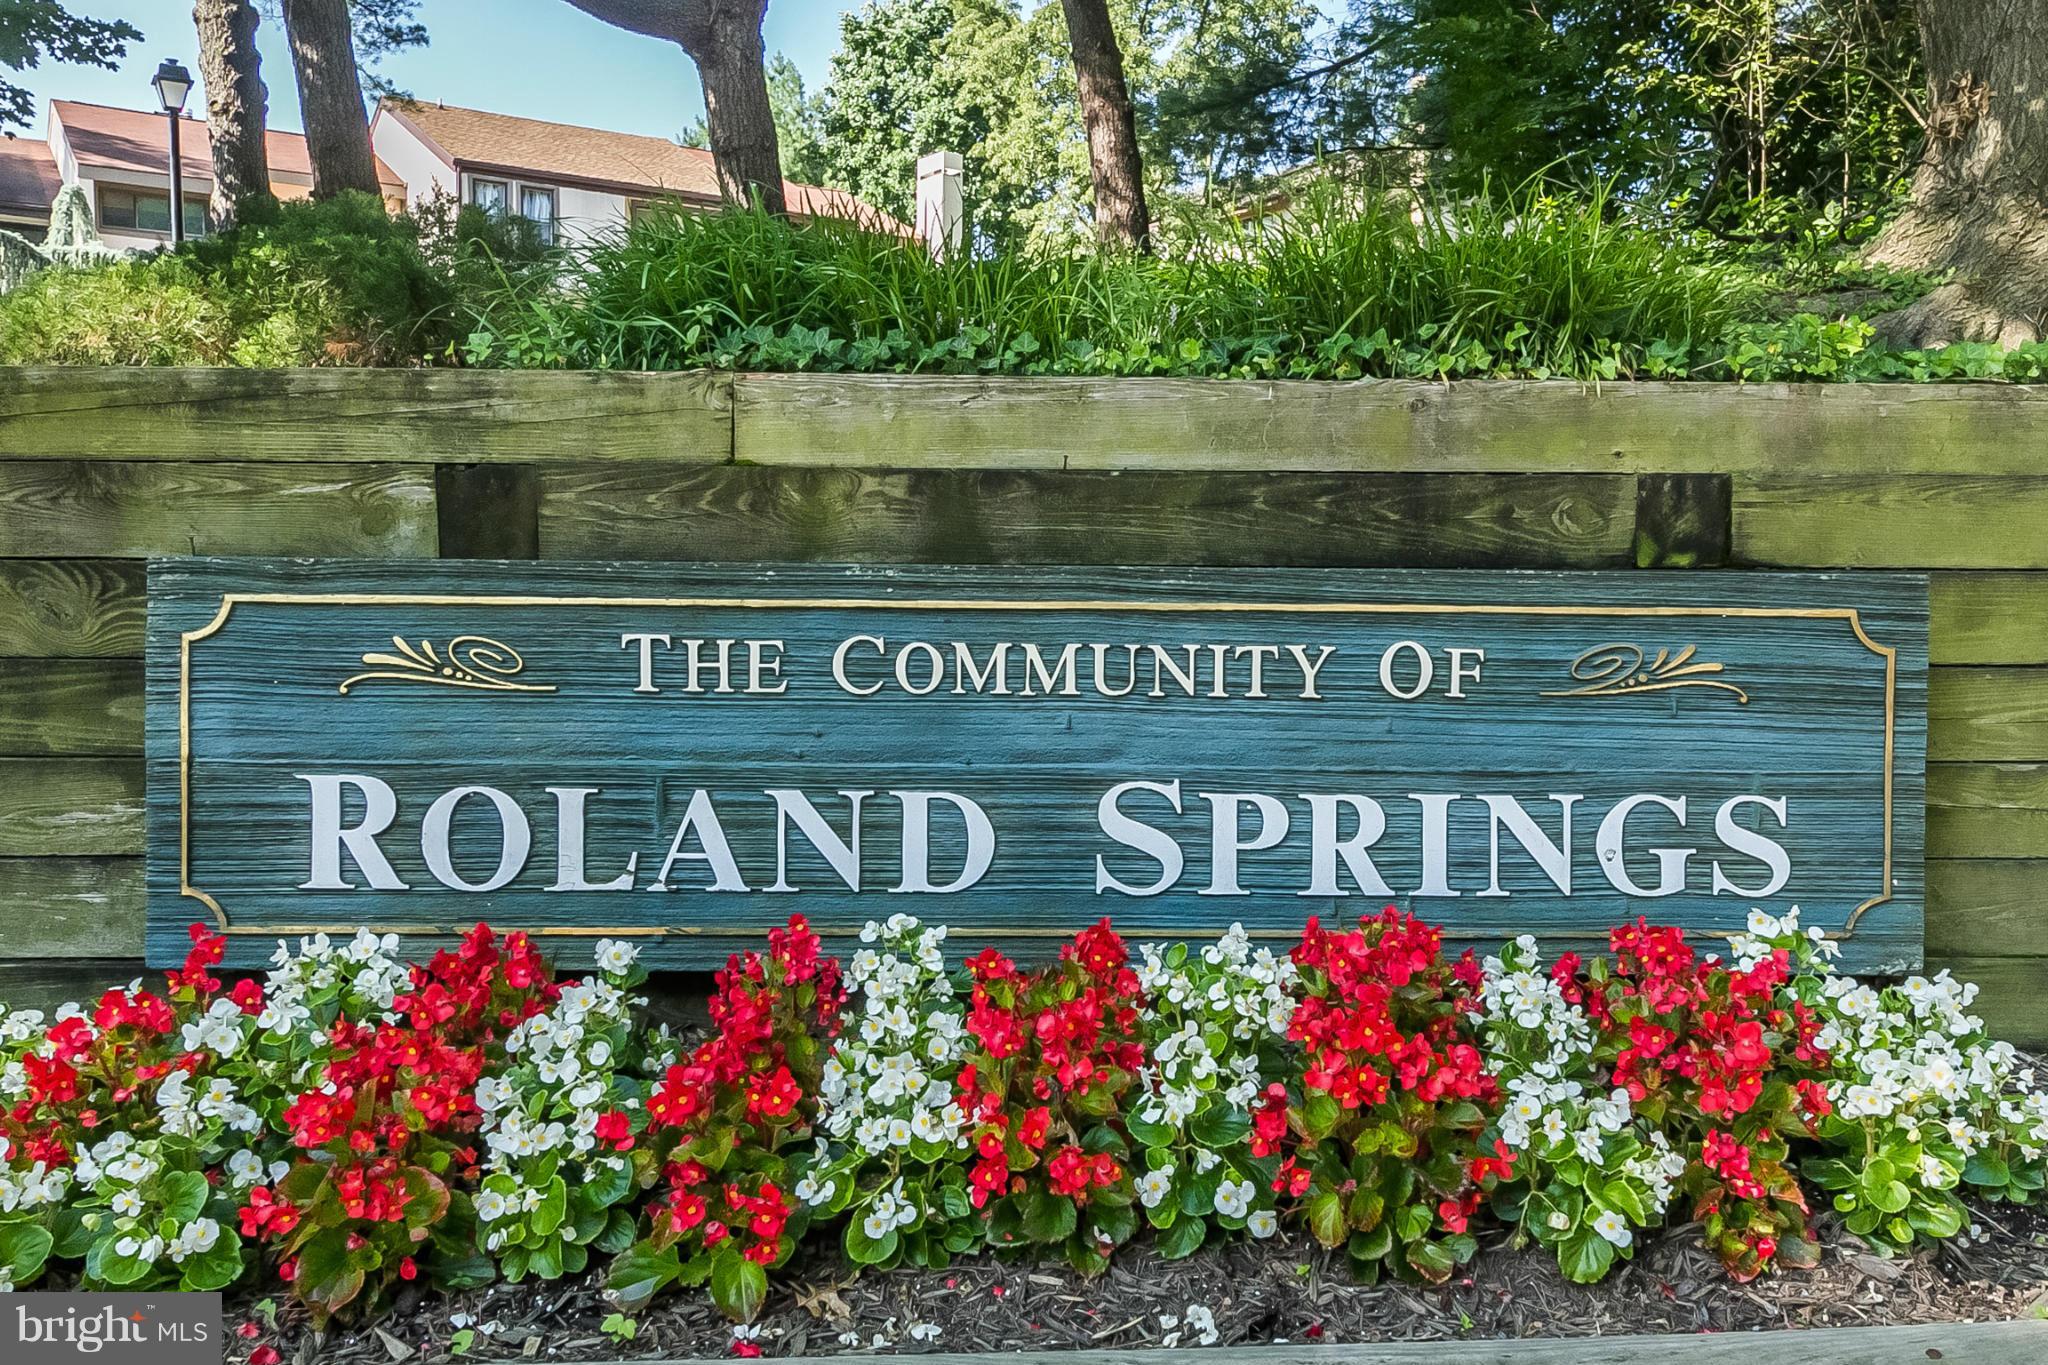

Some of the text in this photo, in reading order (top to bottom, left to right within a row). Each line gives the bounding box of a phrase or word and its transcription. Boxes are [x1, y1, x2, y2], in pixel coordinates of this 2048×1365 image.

[619, 632, 1486, 702] THE COMMUNITY OF
[291, 772, 1793, 900] ROLAND SPRINGS
